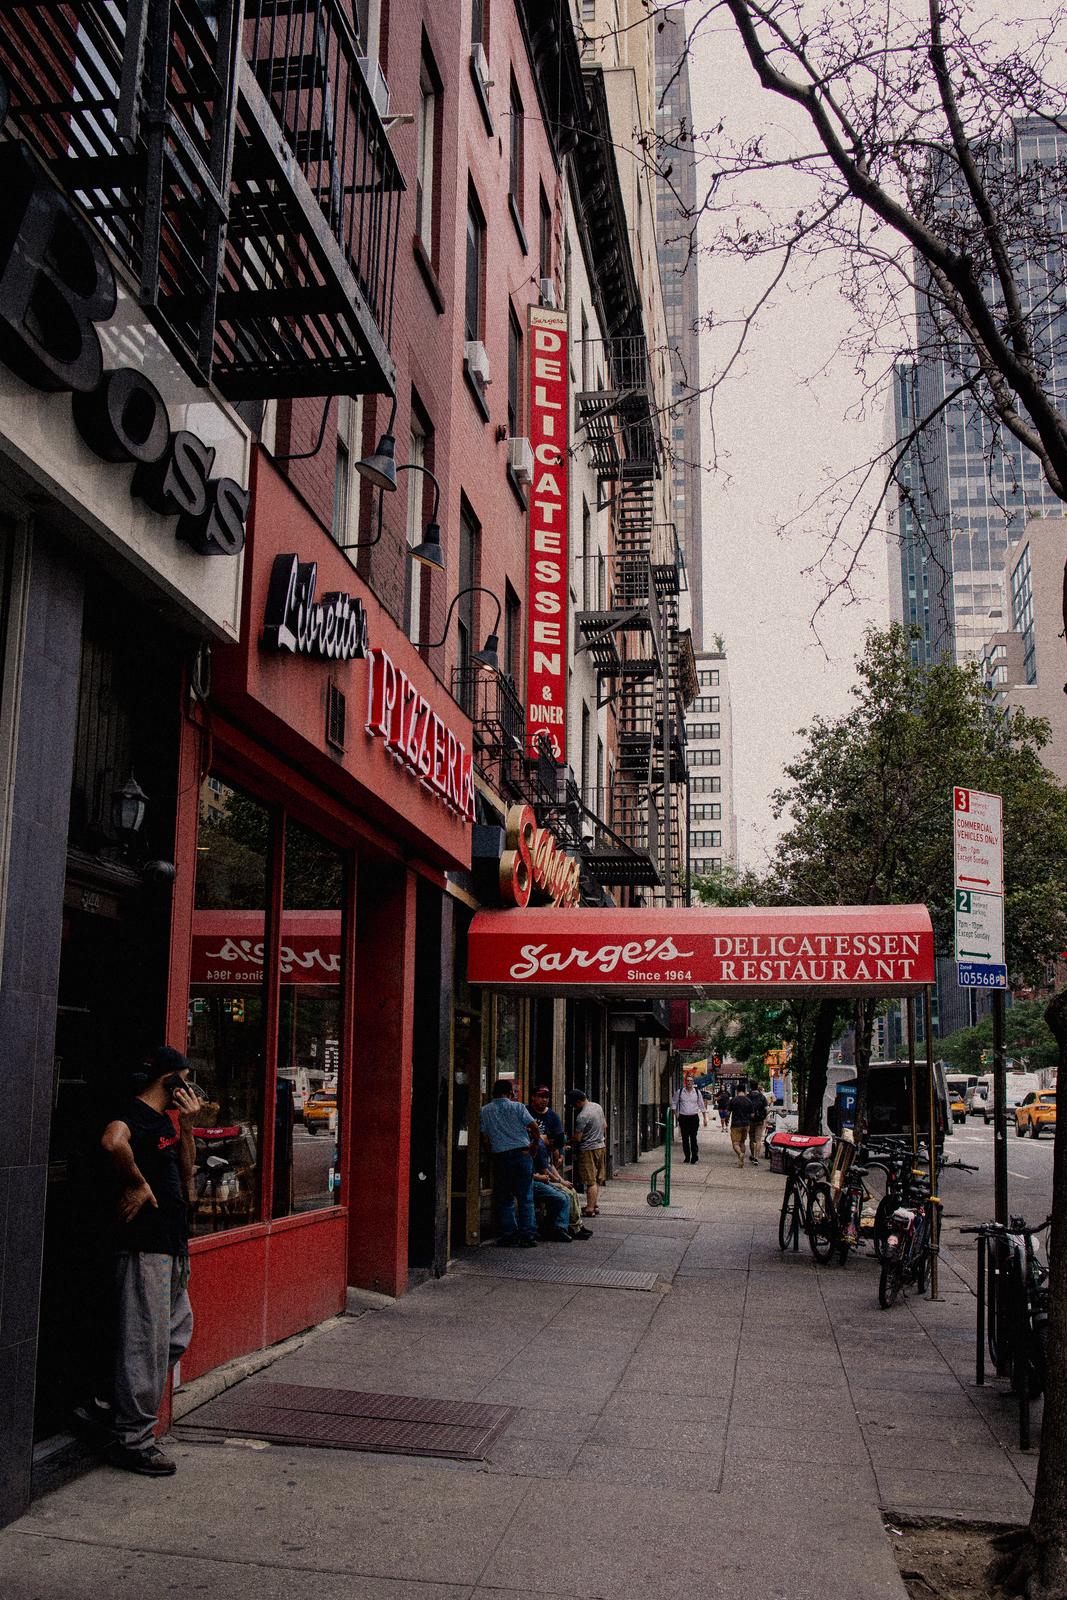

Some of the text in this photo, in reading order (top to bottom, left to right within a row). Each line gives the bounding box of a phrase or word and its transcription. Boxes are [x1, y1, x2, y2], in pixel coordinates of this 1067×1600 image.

[533, 329, 562, 676] DELICATESSEN
[541, 685, 553, 701] &
[530, 703, 564, 725] DINER
[365, 648, 476, 823] PIZZERIA
[958, 791, 966, 810] 3
[957, 819, 993, 834] COMMERCIAL
[957, 830, 999, 845] VEHICLES ONLY
[973, 856, 990, 866] Sunday
[959, 891, 968, 911] 2
[958, 929, 991, 942] Except Sunday
[713, 934, 921, 957] DELICATESSEN
[509, 935, 695, 979] Sarge's
[627, 970, 692, 981] Since 1964
[719, 959, 916, 981] RESTAURANT
[960, 972, 995, 985] 105568
[846, 1096, 855, 1110] P
